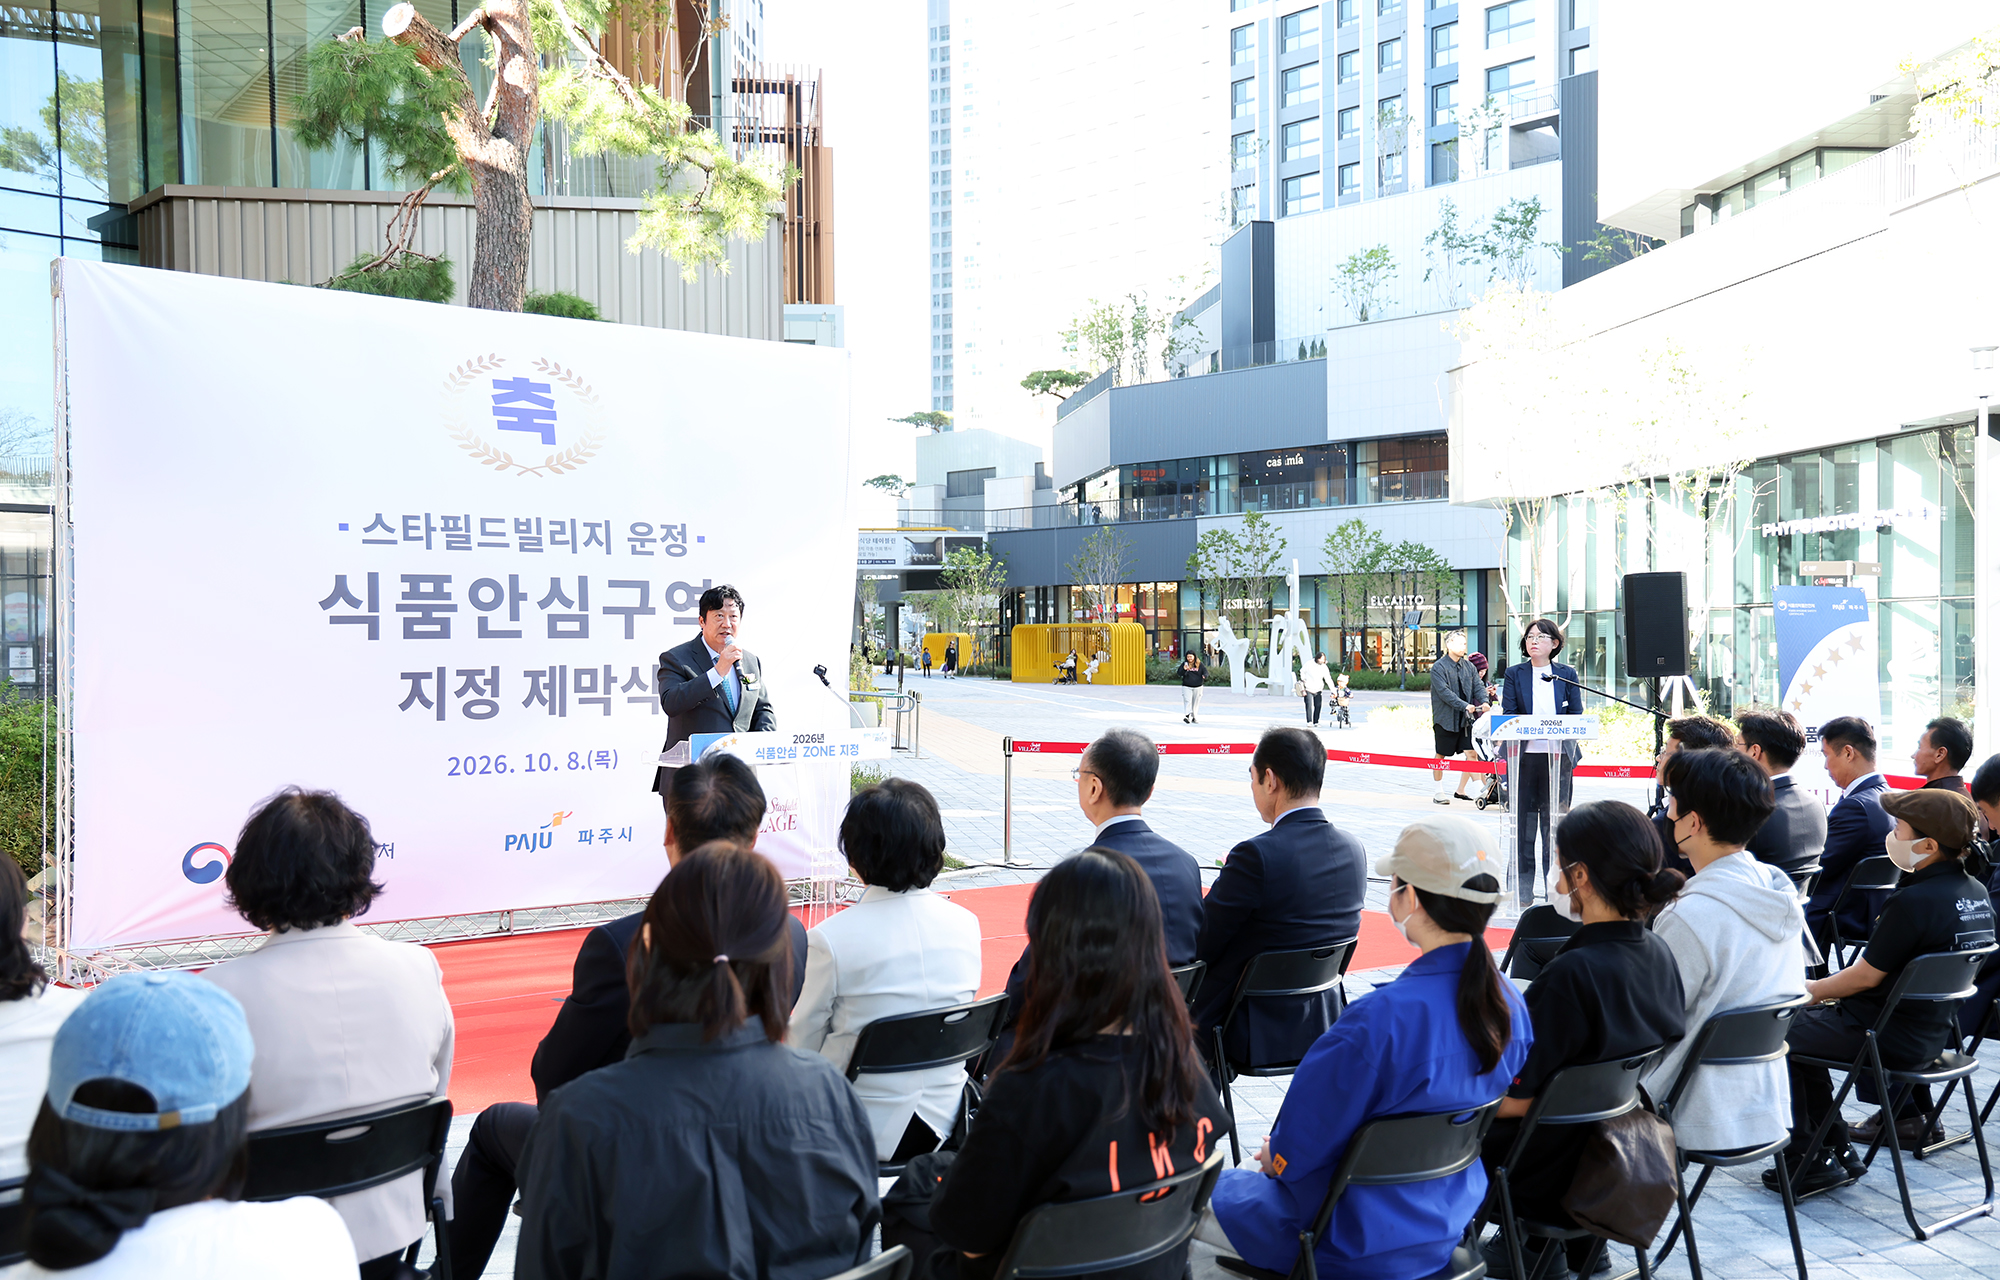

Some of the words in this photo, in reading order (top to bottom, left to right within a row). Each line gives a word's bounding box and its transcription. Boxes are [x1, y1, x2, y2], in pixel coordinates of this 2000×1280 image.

[492, 377, 558, 445] 축
[362, 513, 612, 555] 스타필드빌리지
[627, 521, 688, 557] 운정
[319, 572, 712, 640] 식품안심구역
[1370, 595, 1425, 606] ELCANTO
[398, 666, 500, 721] 지정
[521, 664, 659, 718] 제막식
[792, 733, 825, 744] 2026년
[1516, 727, 1544, 735] 식품안심
[1572, 727, 1587, 735] 지정
[447, 755, 515, 776] 2026.
[524, 752, 559, 772] 10.
[567, 749, 618, 771] 8.(목)
[755, 747, 797, 759] 식품안심
[803, 746, 836, 758] ZONE
[840, 744, 860, 757] 지정
[504, 831, 553, 853] PAJU
[578, 826, 633, 845] 파주시
